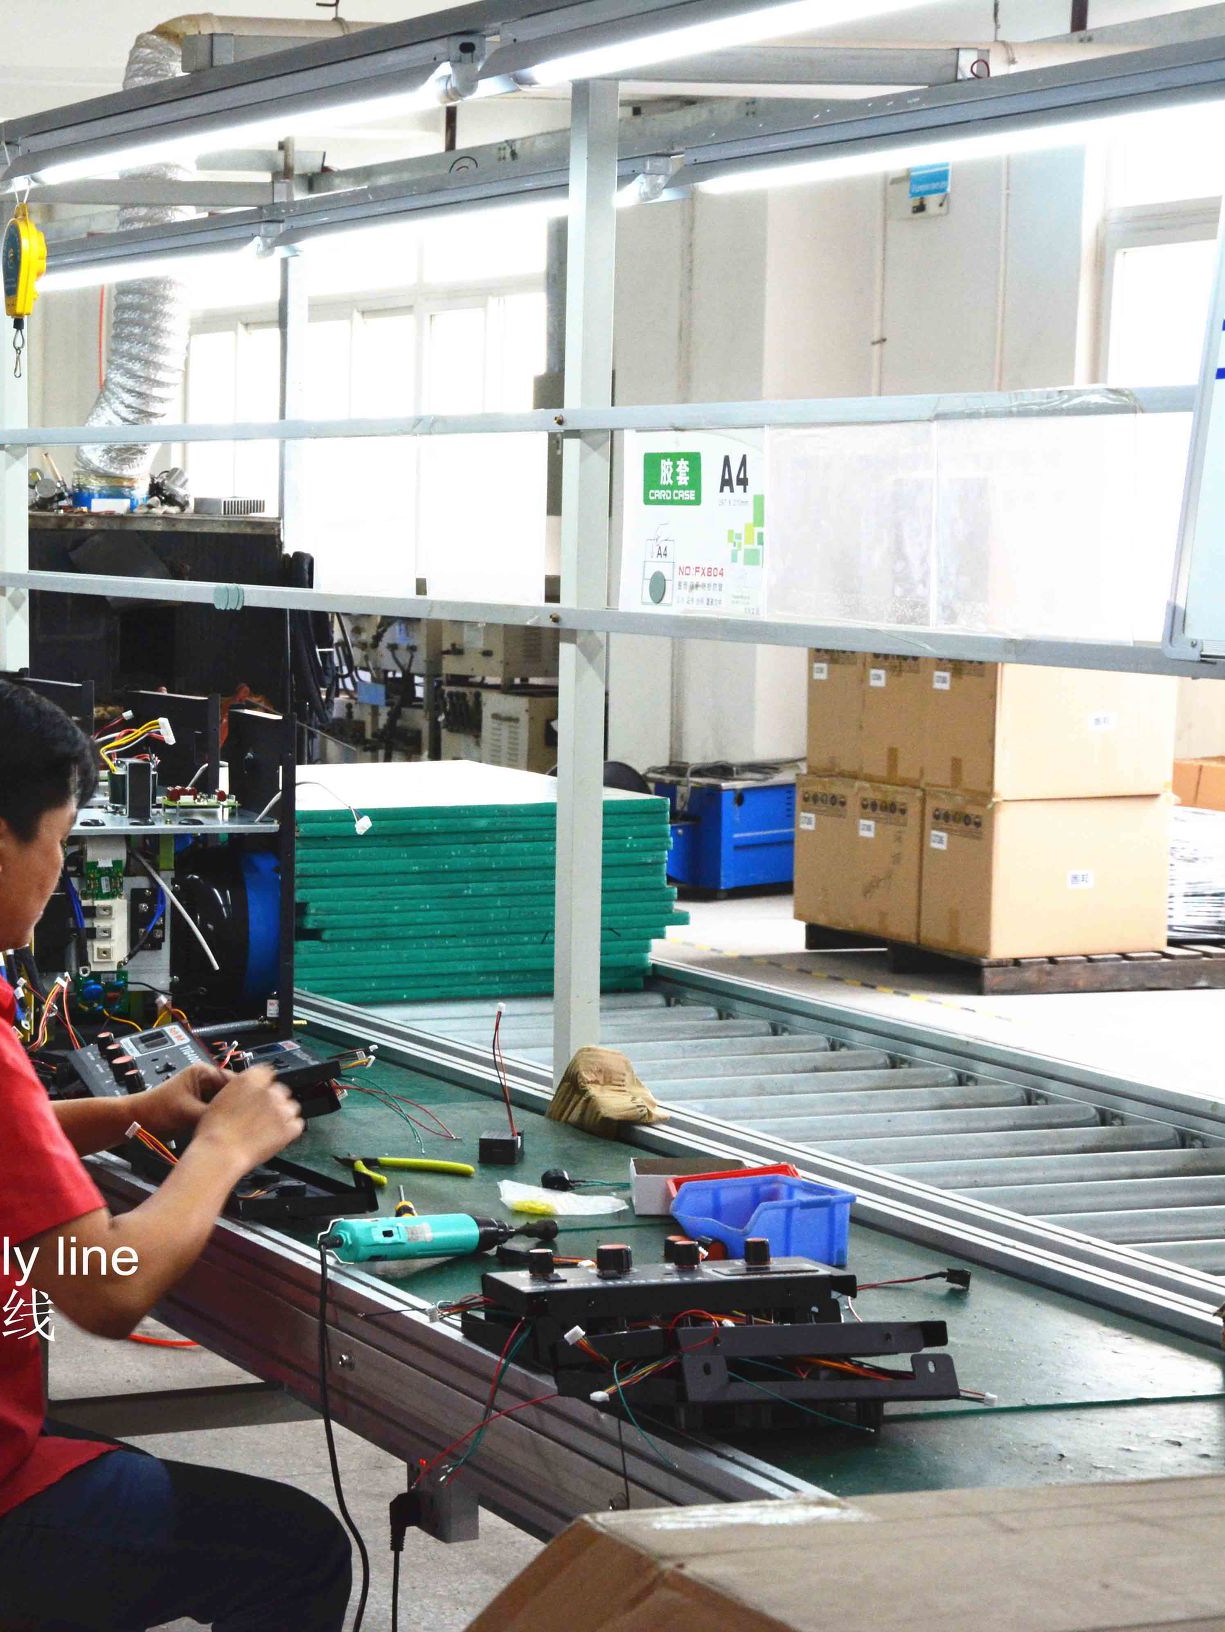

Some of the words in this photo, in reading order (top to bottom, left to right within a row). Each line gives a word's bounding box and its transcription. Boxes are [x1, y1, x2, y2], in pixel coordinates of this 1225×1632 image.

[660, 457, 690, 486] 胶套
[719, 454, 749, 493] A4
[648, 489, 671, 500] CARD
[673, 489, 696, 500] CASE
[656, 545, 668, 559] A4
